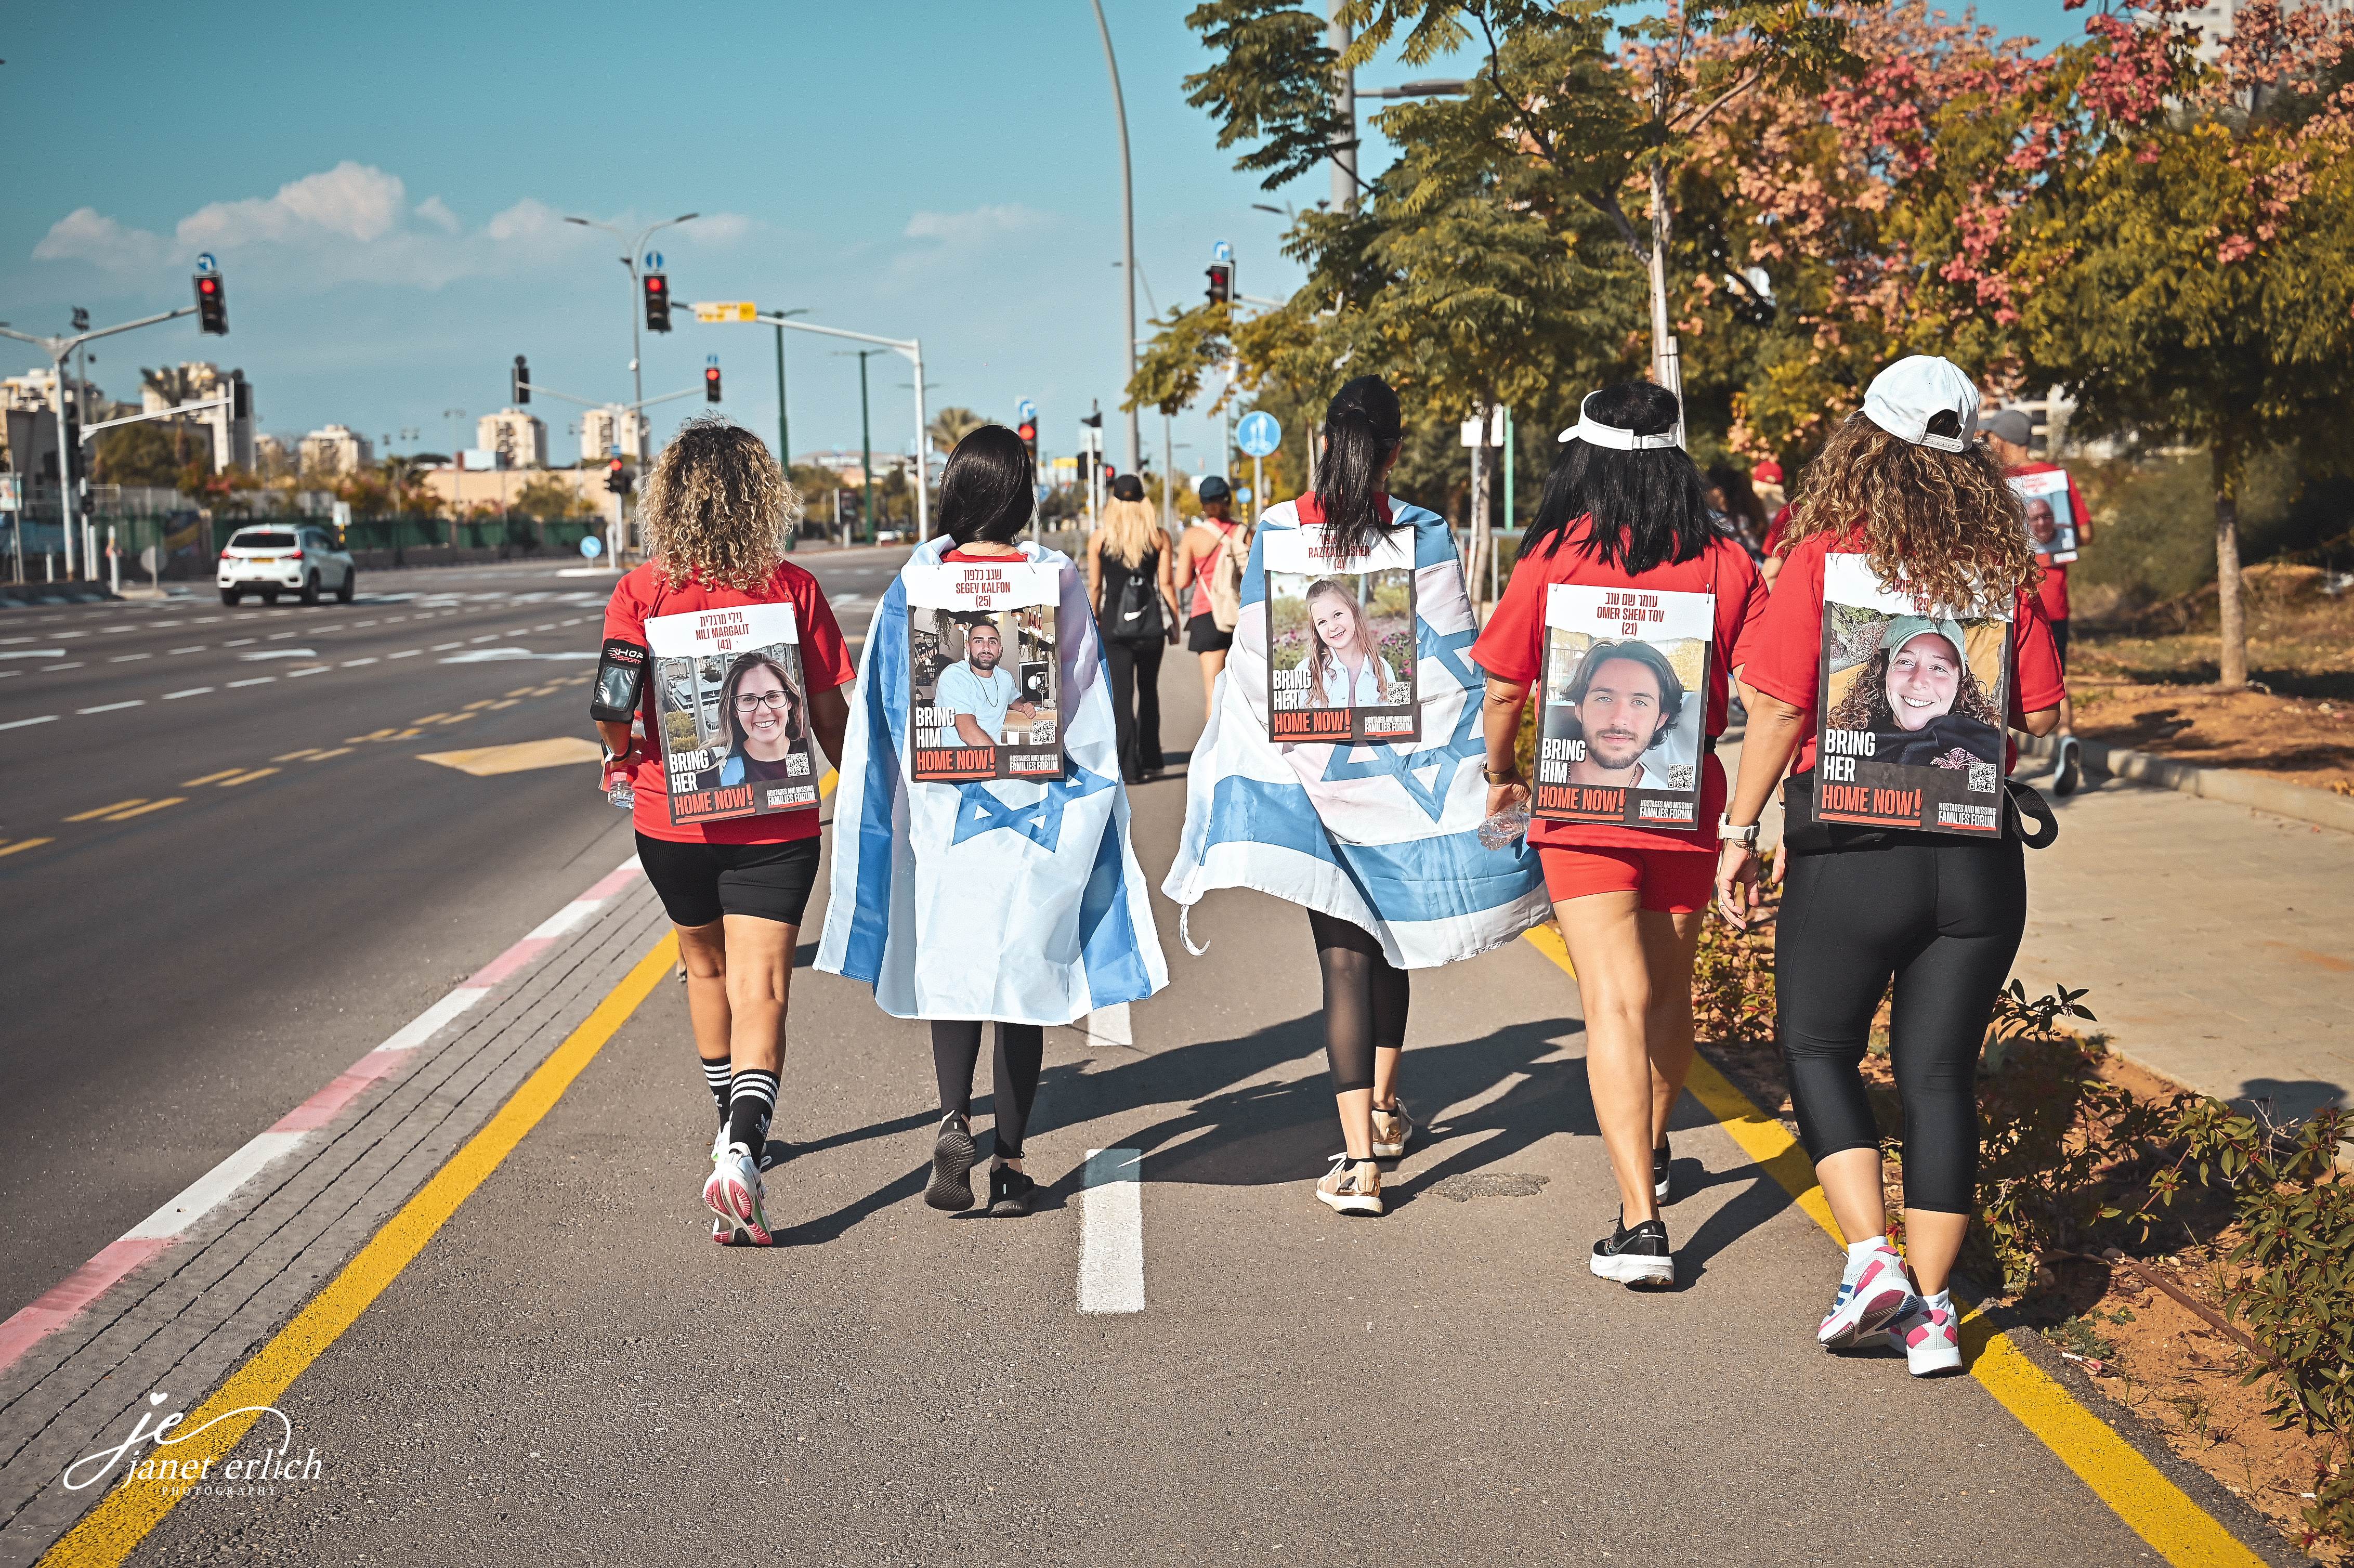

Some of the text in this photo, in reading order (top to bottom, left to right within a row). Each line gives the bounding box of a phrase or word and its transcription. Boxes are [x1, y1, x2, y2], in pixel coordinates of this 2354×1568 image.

[1309, 547, 1324, 558] RAZ
[1326, 546, 1345, 557] KA
[1335, 558, 1345, 571] (4)
[963, 568, 1001, 582] שגב כלפון
[956, 582, 1010, 594] SEGEV KALFON
[976, 595, 991, 608] (25)
[1605, 592, 1658, 607] עומר שם טוב
[1914, 596, 1932, 612] (29
[699, 612, 742, 627] נילי מרגלית
[1597, 606, 1665, 622] OMER SHEM TOV
[696, 623, 749, 640] NILI MARGALIT
[1621, 621, 1637, 636] (21)
[717, 637, 731, 651] (41)
[617, 655, 642, 664] SPORT
[1273, 669, 1312, 689] BRING
[1273, 690, 1299, 710] HER
[915, 707, 956, 727] BRING
[1274, 708, 1352, 733] HOME NOW!
[1365, 721, 1413, 733] FAMILIES FORUM
[916, 727, 941, 748] HIM
[1824, 728, 1875, 756] BRING
[1541, 737, 1586, 762] BRING
[668, 749, 710, 774] BRING
[917, 747, 997, 771] HOME NOW!
[1010, 761, 1058, 772] FAMILIES FORUM
[1539, 761, 1568, 783] HIM
[1823, 756, 1855, 782] HER
[671, 772, 699, 794] HER
[766, 788, 788, 797] HOSTAGES
[795, 785, 814, 793] MISSING
[674, 784, 754, 816] HOME NOW!
[767, 791, 816, 806] FAMILIES FORUM
[1538, 785, 1626, 813] HOME NOW!
[1640, 799, 1664, 808] HOSTAGES
[1672, 801, 1693, 810] MISSING
[1821, 784, 1923, 817] HOME NOW!
[1639, 806, 1693, 820] FAMILIES FORUM
[1939, 802, 1996, 816] HOSTAGES AND MISSING
[1938, 810, 1996, 828] FAMILIES FORUM
